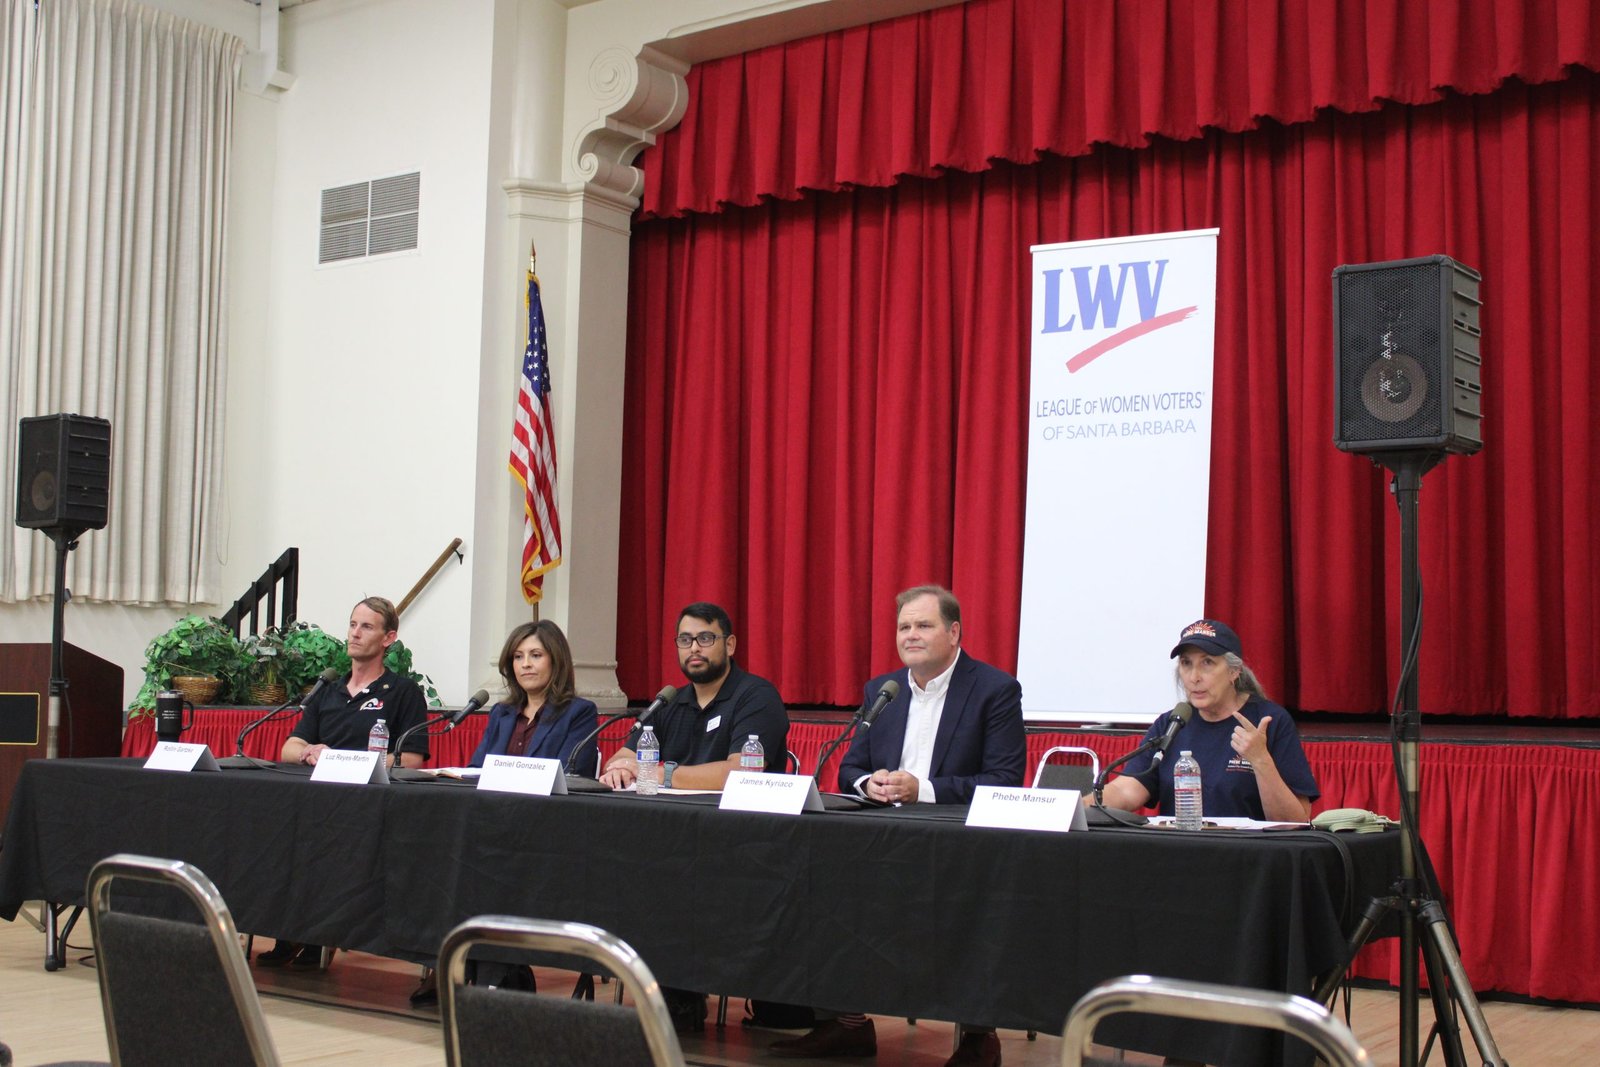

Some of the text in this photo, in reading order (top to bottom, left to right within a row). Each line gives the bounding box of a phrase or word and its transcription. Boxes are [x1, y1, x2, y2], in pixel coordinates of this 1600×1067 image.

[1041, 259, 1169, 334] LWV
[1036, 398, 1082, 418] LEAGUE
[1084, 400, 1098, 415] OF
[1099, 394, 1150, 414] WOMEN
[1042, 418, 1197, 441] OF SANTA BARBARA
[494, 759, 546, 770] Daniel Gonzalez
[739, 777, 794, 788] James Kyriaco
[992, 791, 1056, 804] Phebe Mansur
